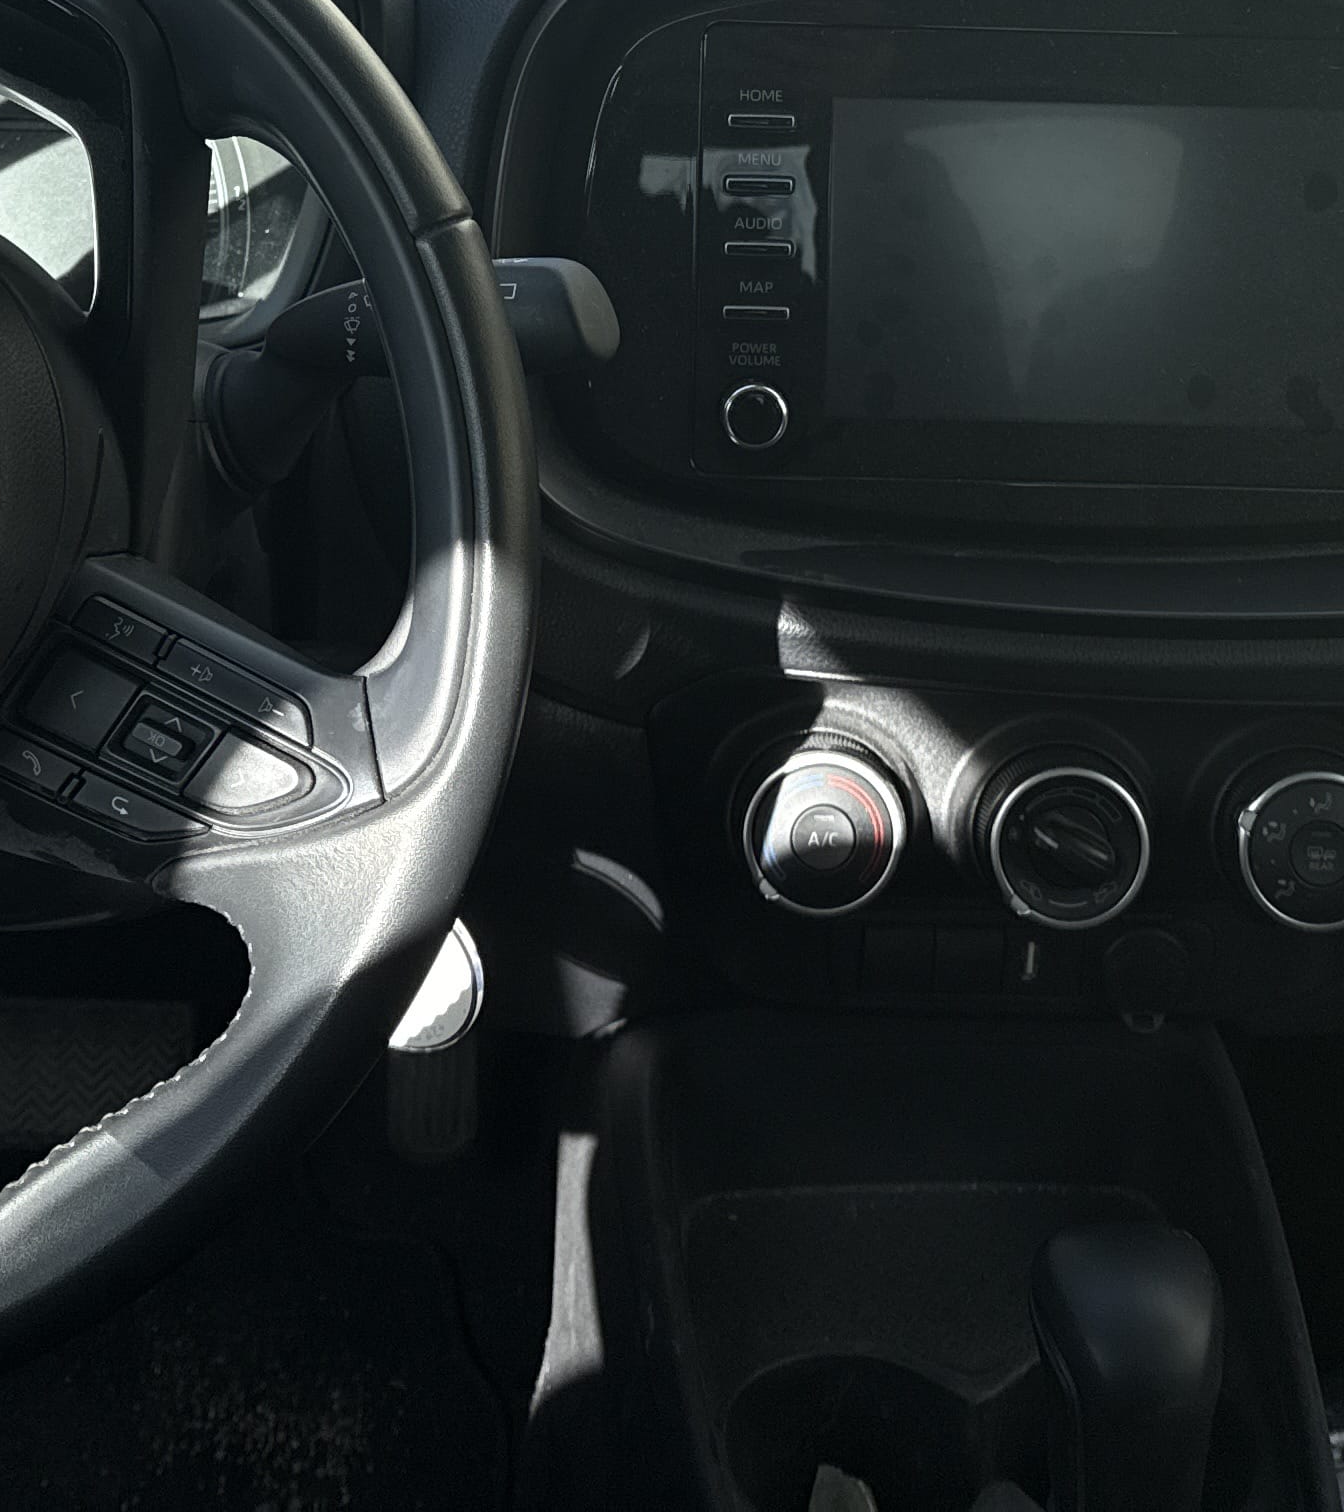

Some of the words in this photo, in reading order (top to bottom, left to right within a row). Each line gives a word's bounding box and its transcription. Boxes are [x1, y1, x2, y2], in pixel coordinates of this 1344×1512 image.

[738, 89, 784, 102] HOME
[737, 152, 782, 166] MENU
[733, 217, 783, 230] AUDIO
[739, 281, 774, 294] MAP
[731, 341, 777, 353] POWER
[728, 354, 783, 367] VOLUME
[146, 730, 167, 748] OK
[807, 831, 840, 848] A/C
